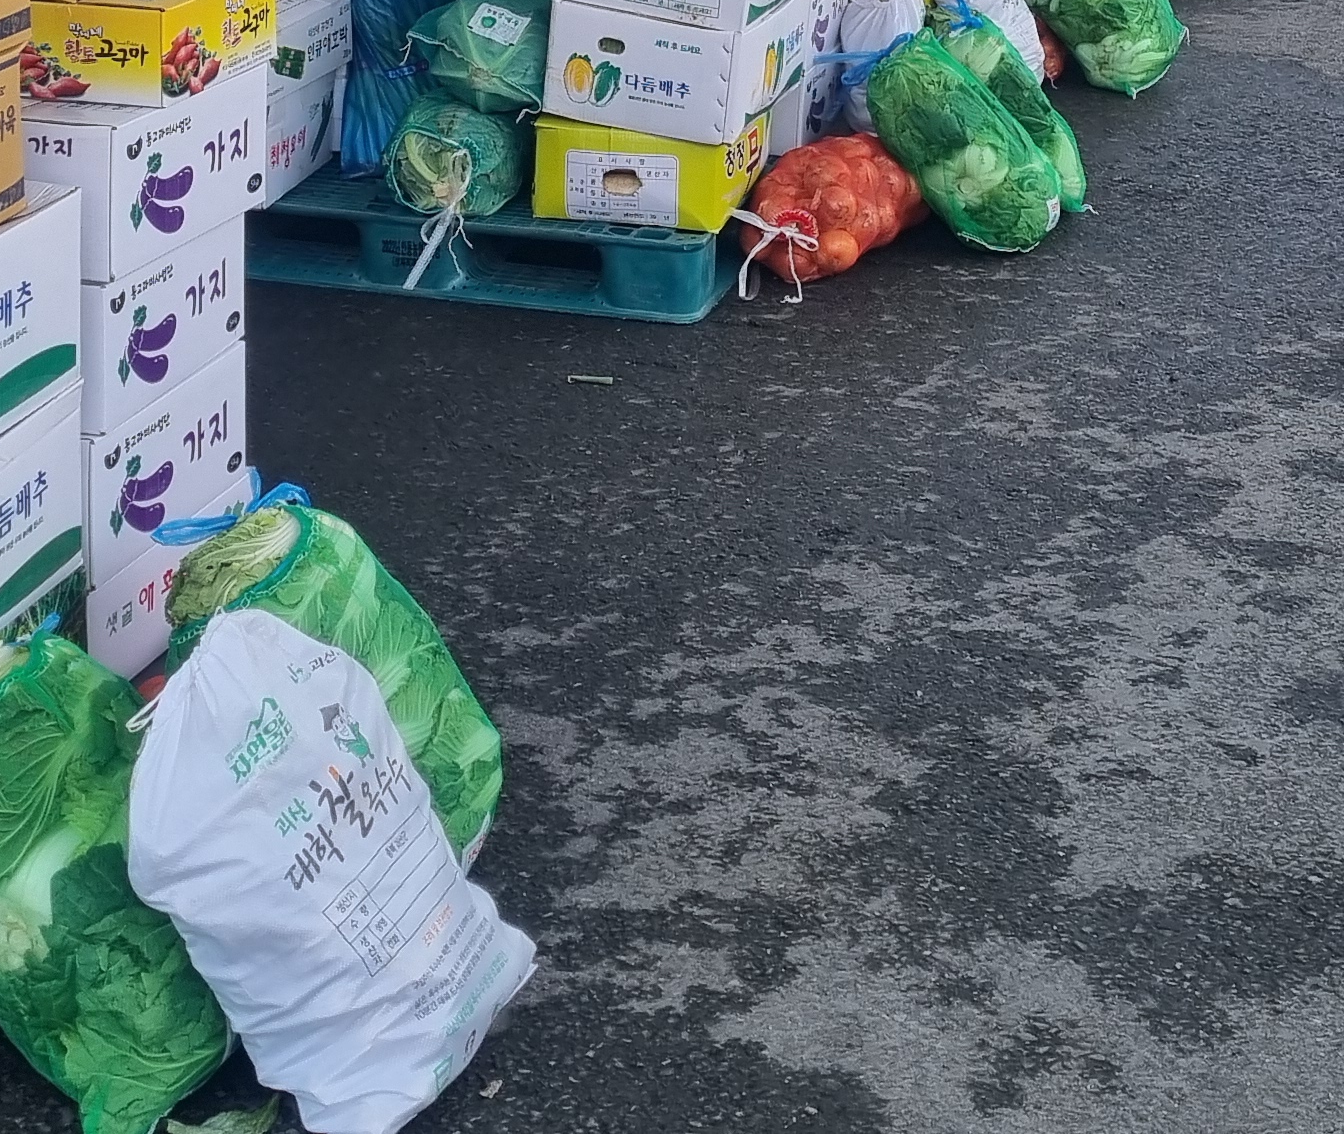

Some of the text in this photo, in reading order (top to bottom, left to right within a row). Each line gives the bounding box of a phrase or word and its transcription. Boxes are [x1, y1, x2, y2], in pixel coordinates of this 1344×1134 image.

[624, 73, 691, 100] 다듬배추
[27, 136, 74, 158] 가지
[203, 117, 249, 175] 가지
[184, 256, 227, 318] 가지
[182, 399, 229, 463] 가지
